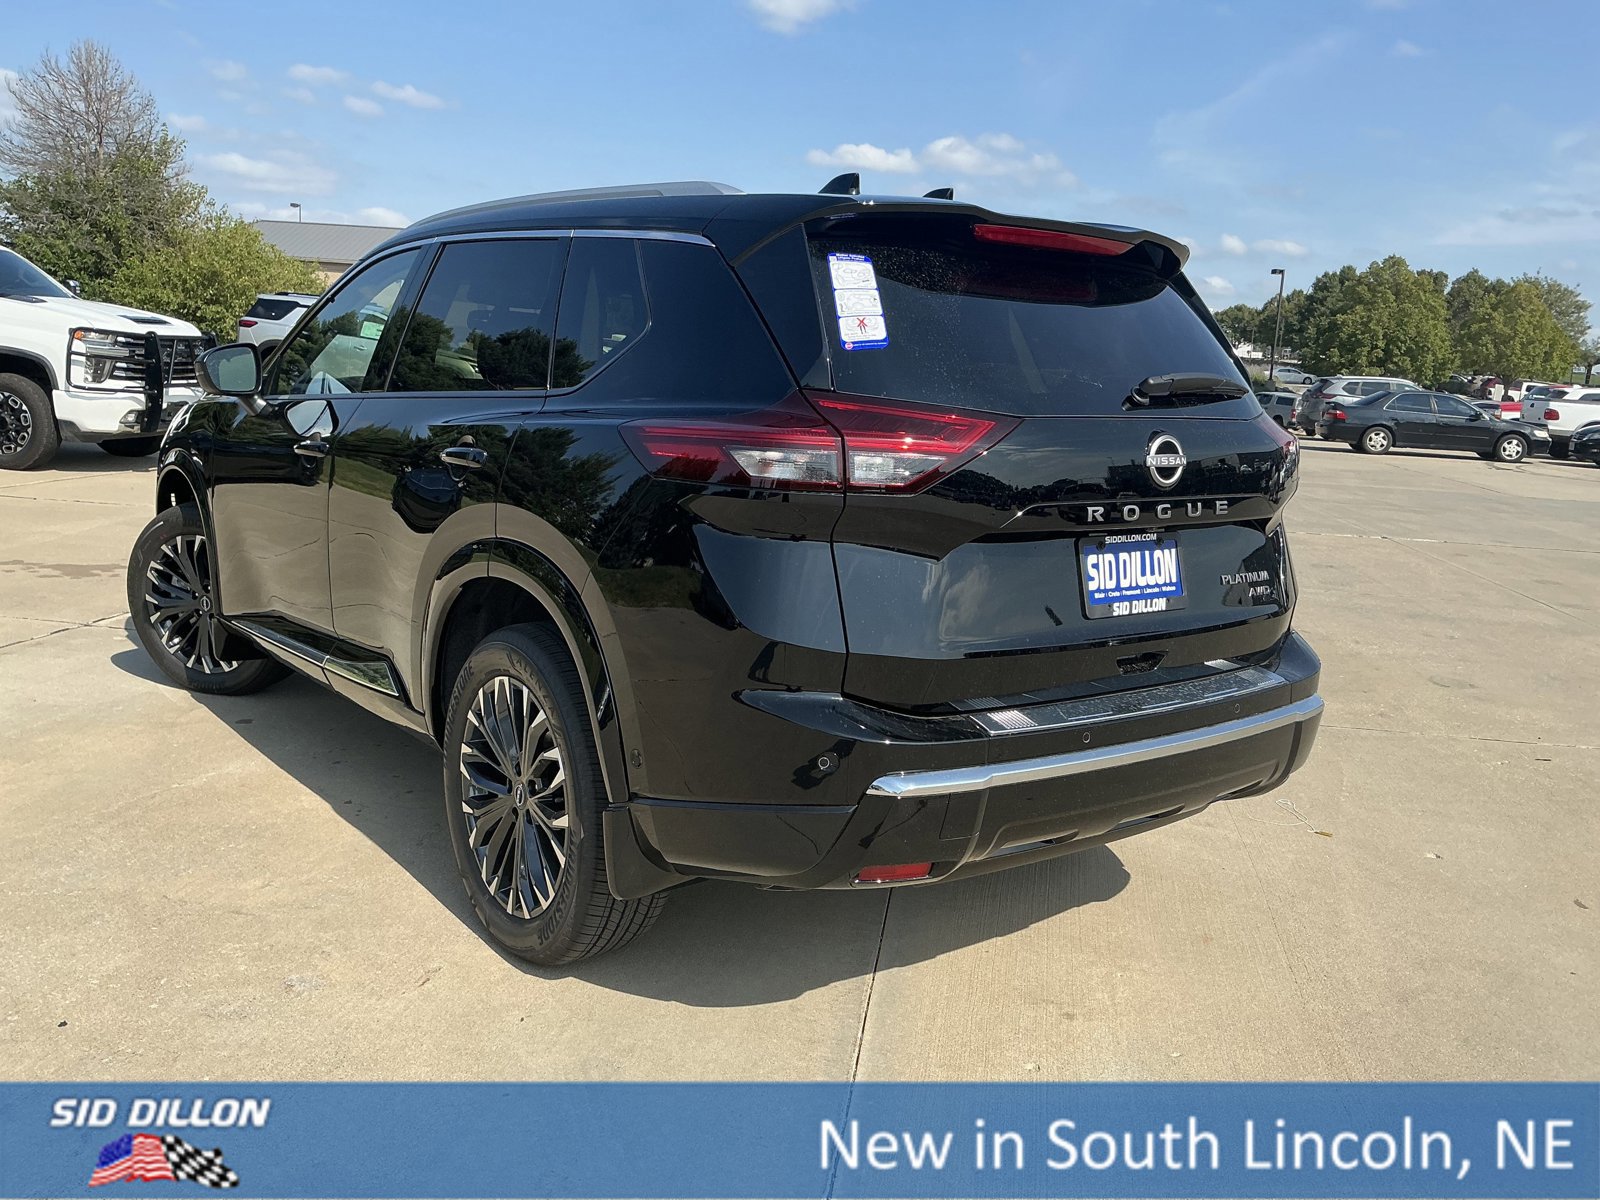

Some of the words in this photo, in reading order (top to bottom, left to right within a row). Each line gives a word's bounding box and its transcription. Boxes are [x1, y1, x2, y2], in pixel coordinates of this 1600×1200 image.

[1148, 456, 1187, 466] NISSAN
[1086, 500, 1229, 522] ROGUE
[1104, 533, 1157, 544] SIDDILLON.COM
[1087, 552, 1116, 591] SID
[1119, 548, 1177, 587] DILLON
[1221, 571, 1270, 586] PLATINUM
[1249, 585, 1270, 597] AWD
[1112, 601, 1130, 616] SID
[1132, 598, 1167, 614] DILLON
